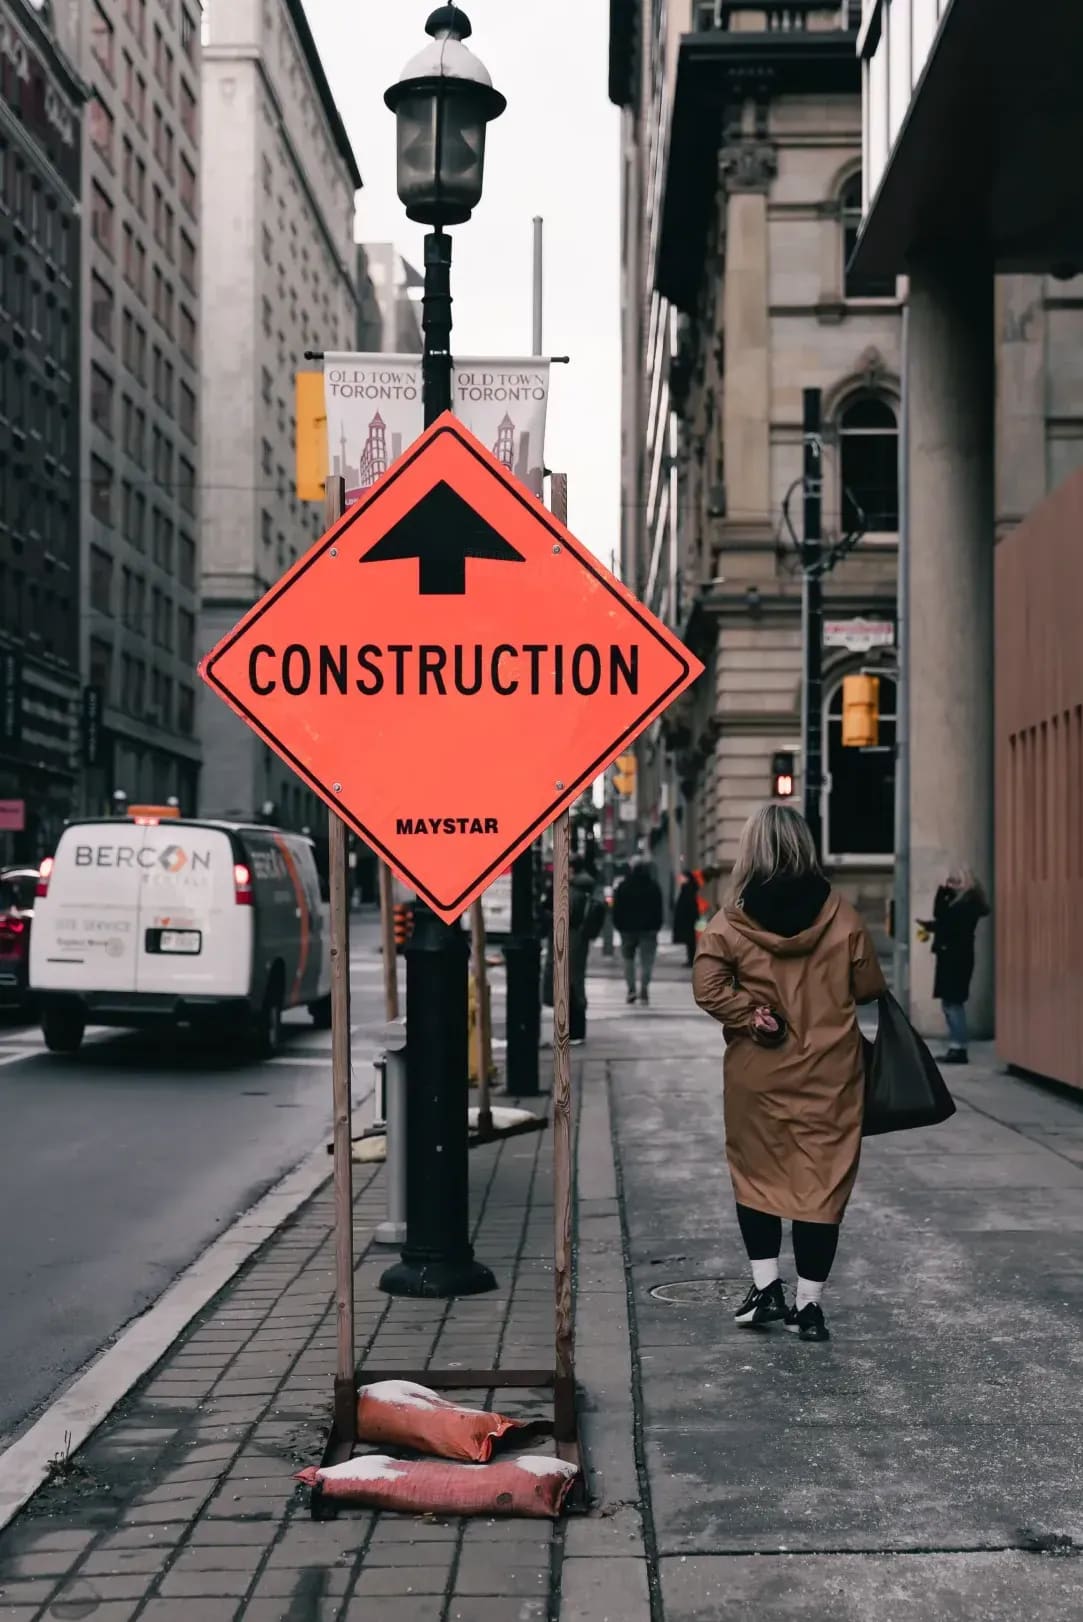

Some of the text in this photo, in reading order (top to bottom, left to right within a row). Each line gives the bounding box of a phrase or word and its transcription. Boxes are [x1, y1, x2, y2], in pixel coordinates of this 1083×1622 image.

[329, 370, 417, 385] OLD TOWN
[458, 373, 544, 386] OLD TOWN
[329, 383, 417, 401] TORONTO
[457, 387, 545, 401] TORONTO
[248, 643, 639, 696] CONSTRUCTION
[396, 817, 499, 835] MAYSTAR
